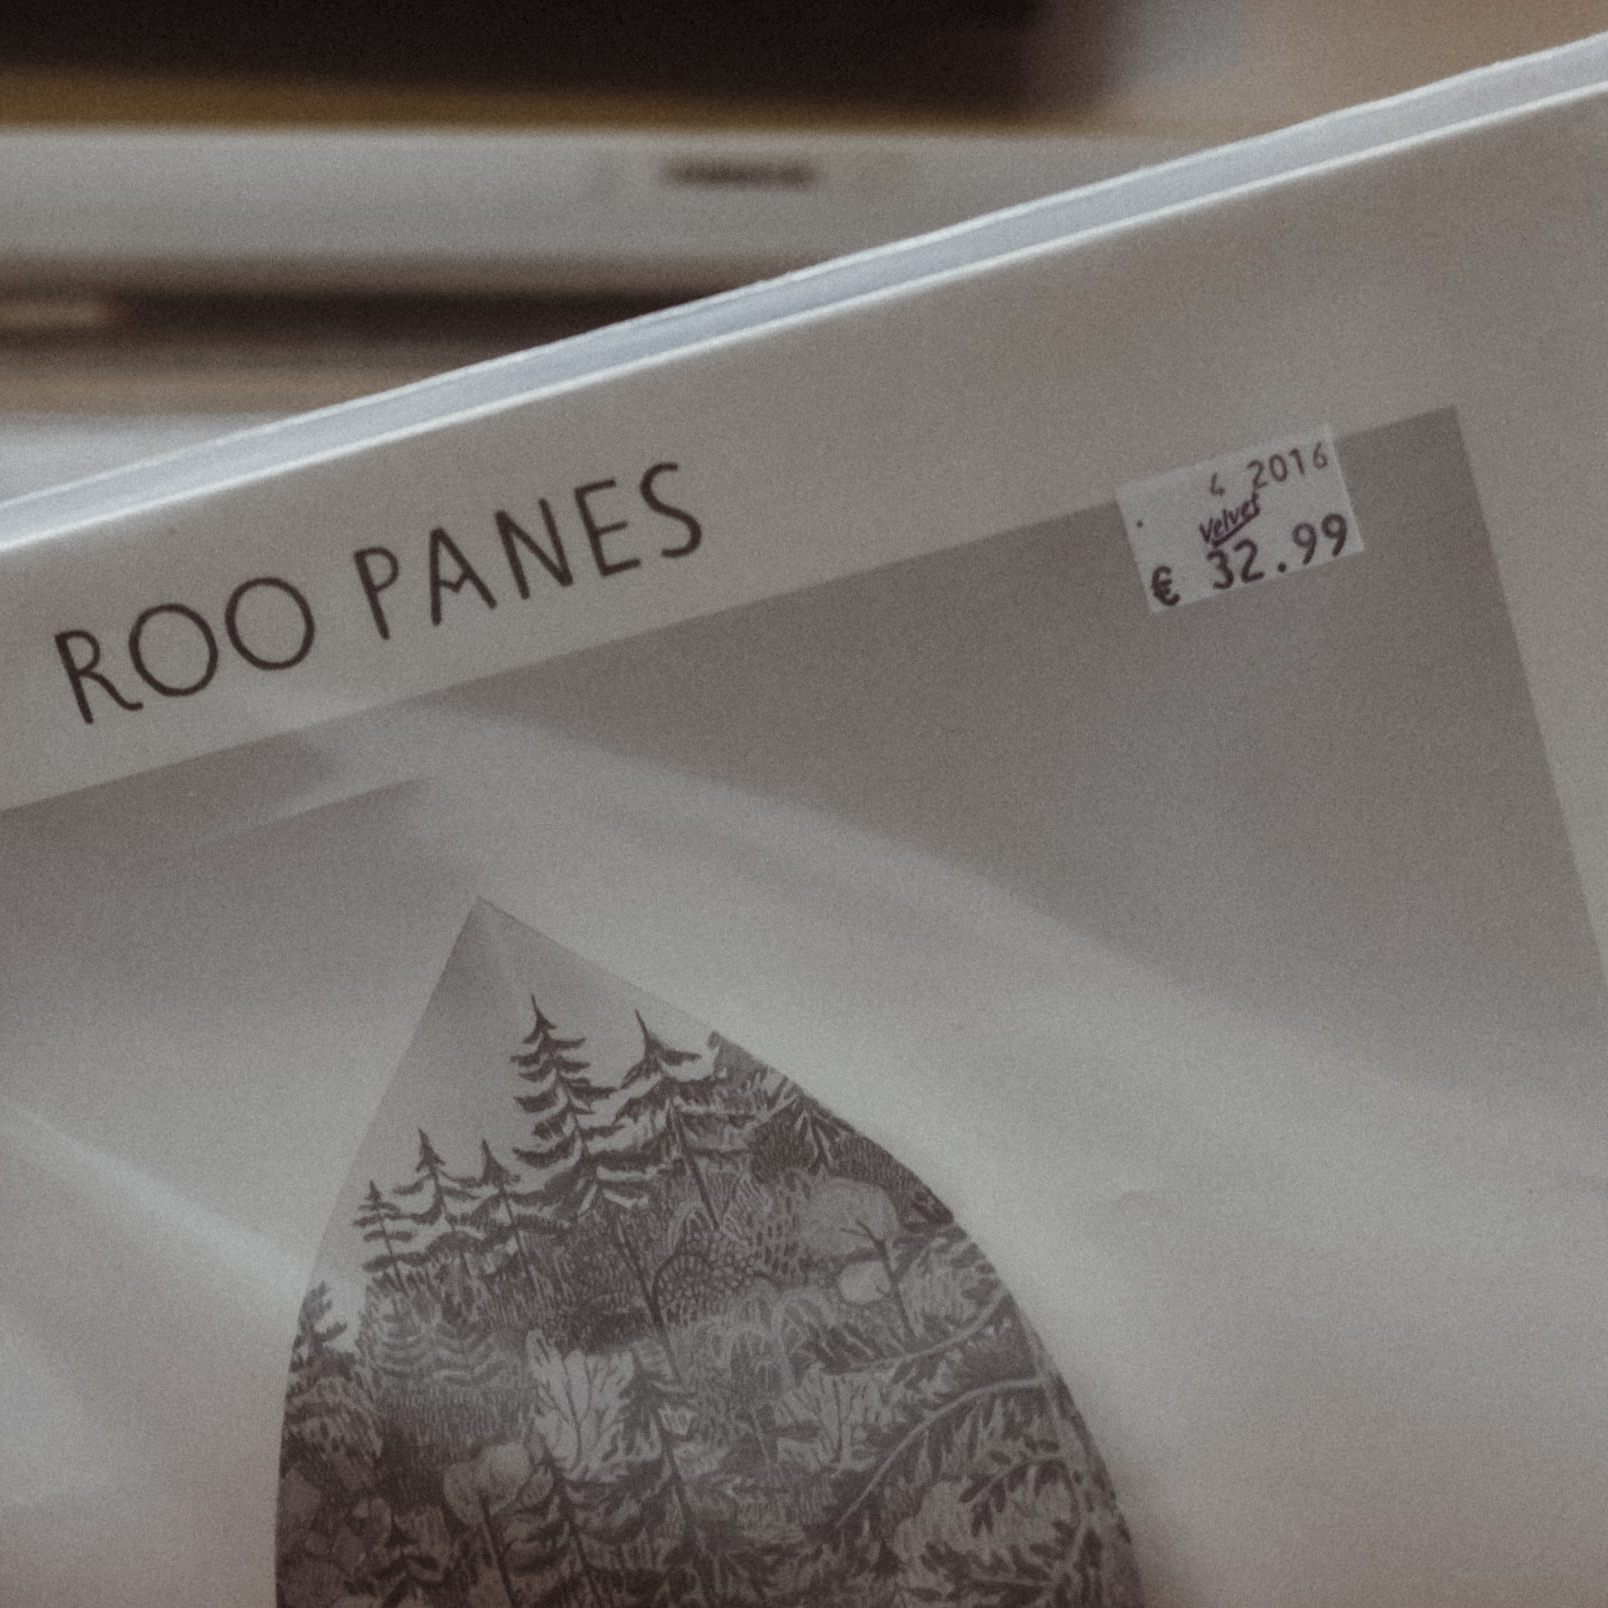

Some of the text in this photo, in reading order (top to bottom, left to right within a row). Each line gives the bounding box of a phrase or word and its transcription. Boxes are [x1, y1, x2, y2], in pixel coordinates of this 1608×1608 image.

[1247, 441, 1329, 490] 2016
[54, 462, 704, 724] ROO PANES
[1149, 512, 1348, 607] € 32.99
